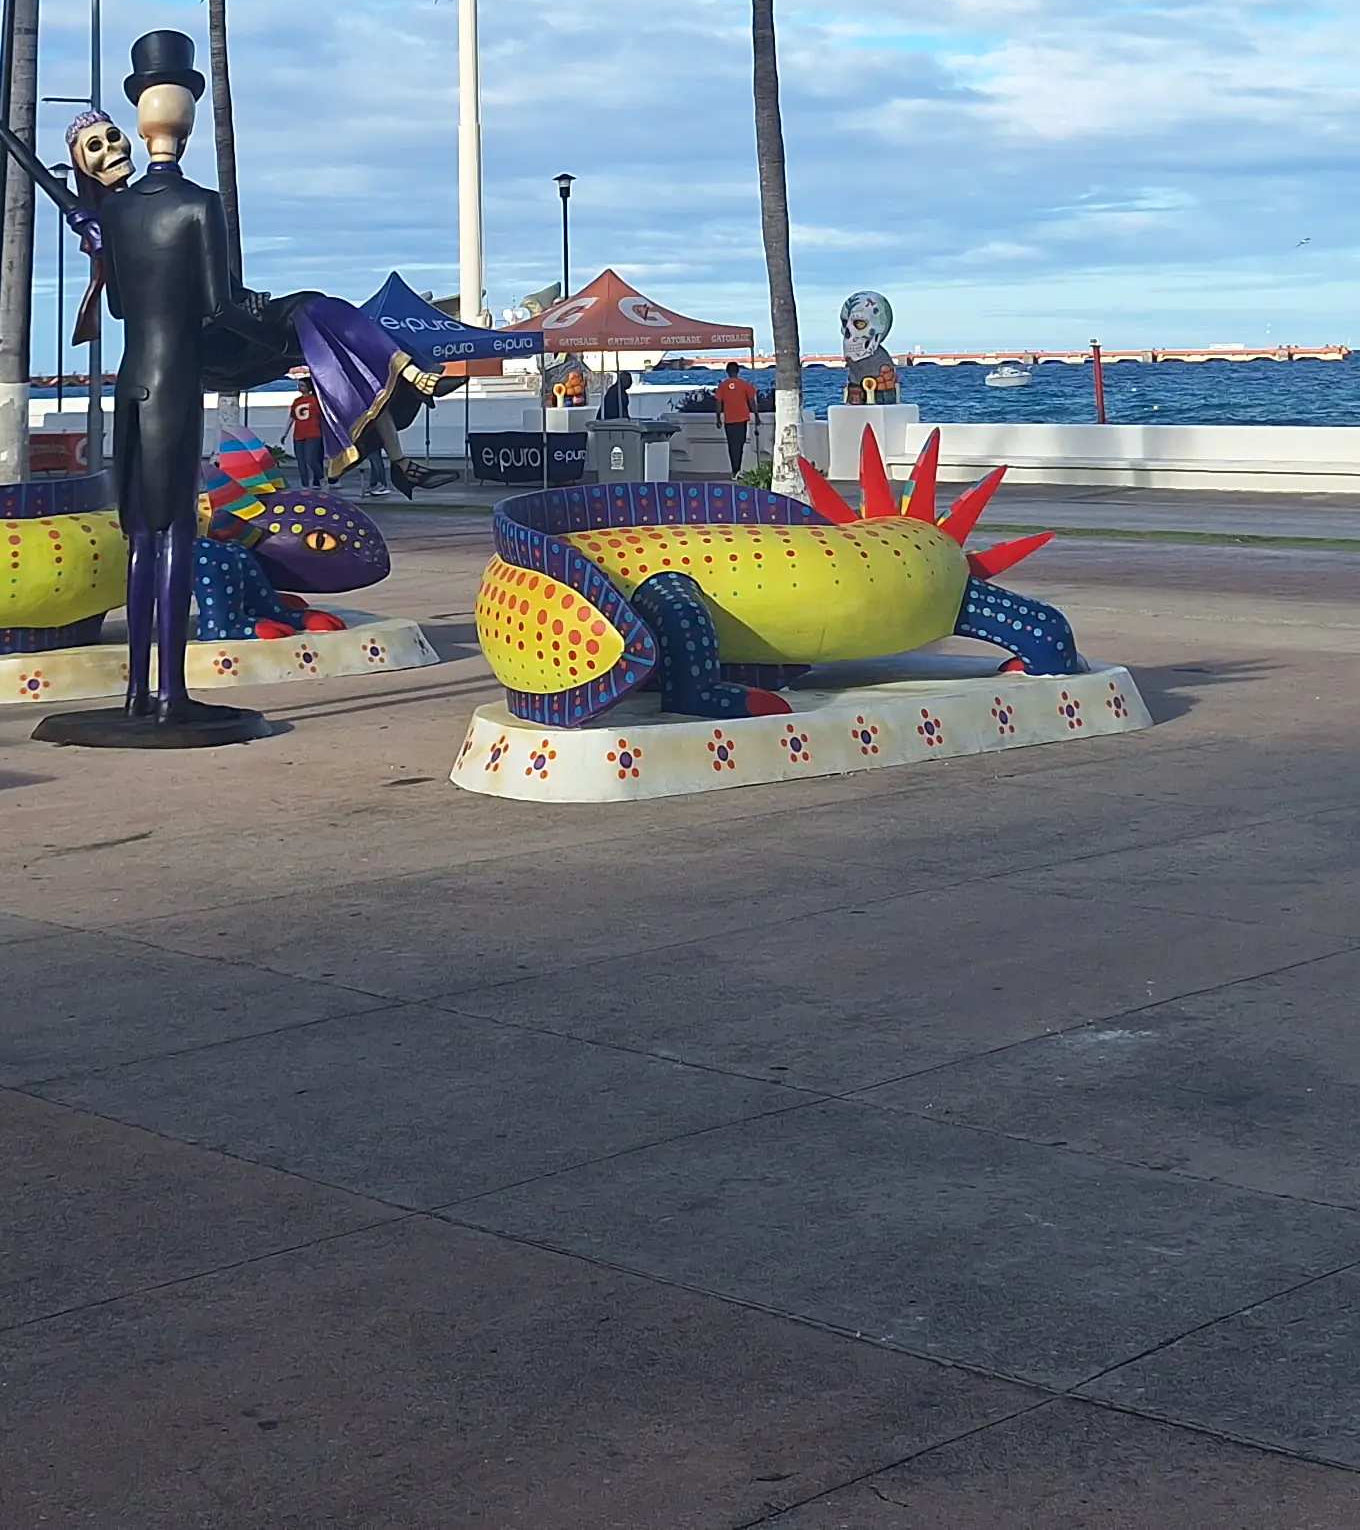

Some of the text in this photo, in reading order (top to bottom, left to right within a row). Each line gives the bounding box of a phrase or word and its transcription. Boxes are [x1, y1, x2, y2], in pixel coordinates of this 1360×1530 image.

[607, 336, 650, 346] GATORADE
[660, 335, 702, 345] GATORADE
[295, 402, 310, 420] G
